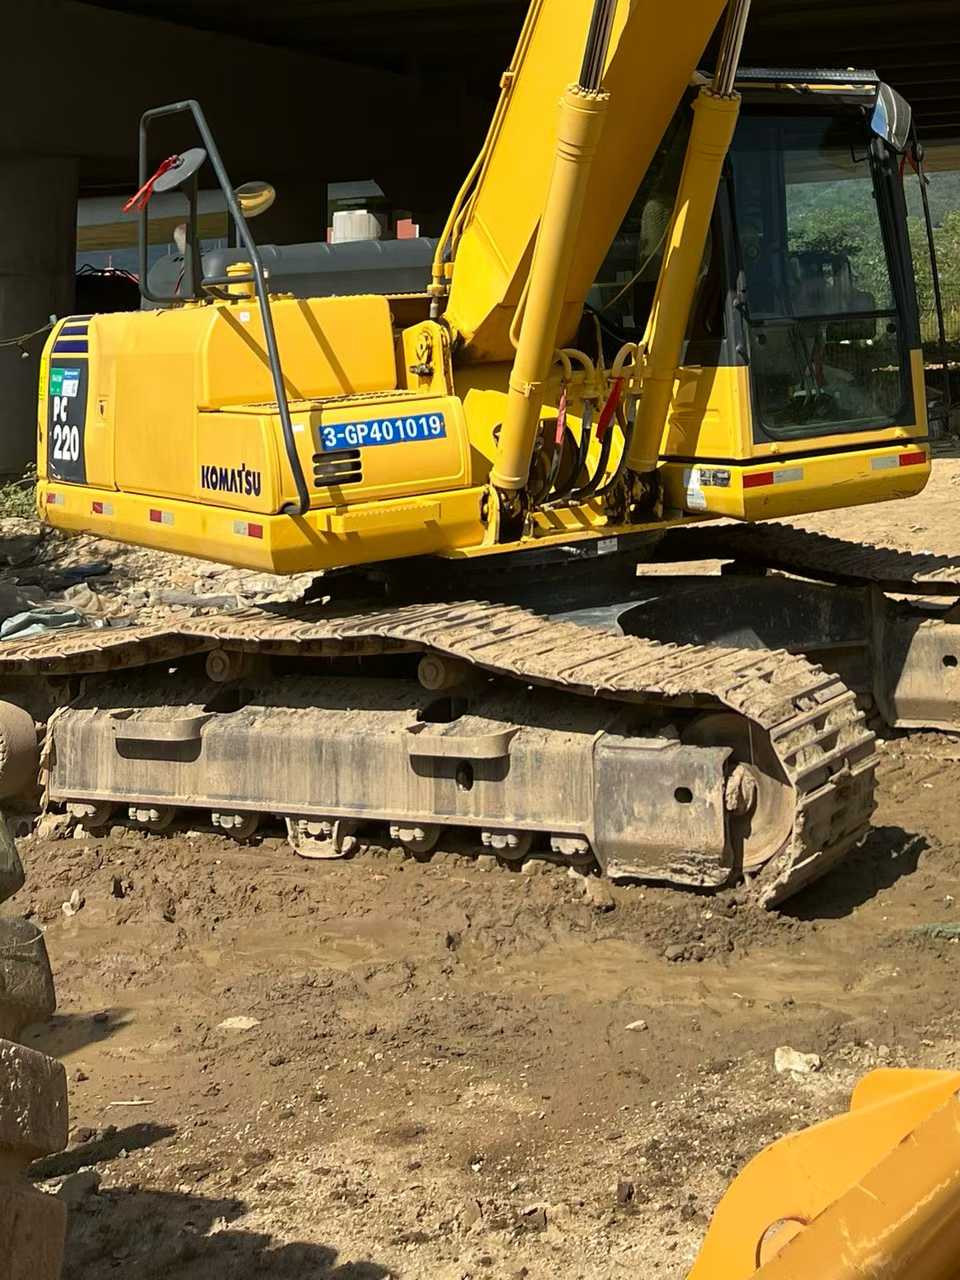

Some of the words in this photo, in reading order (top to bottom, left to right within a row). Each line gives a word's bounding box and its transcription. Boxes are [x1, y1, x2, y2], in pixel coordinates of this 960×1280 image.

[53, 396, 68, 422] PC
[53, 424, 79, 462] 220
[323, 415, 441, 447] 3-GP401019
[201, 463, 261, 497] KOMATSU
